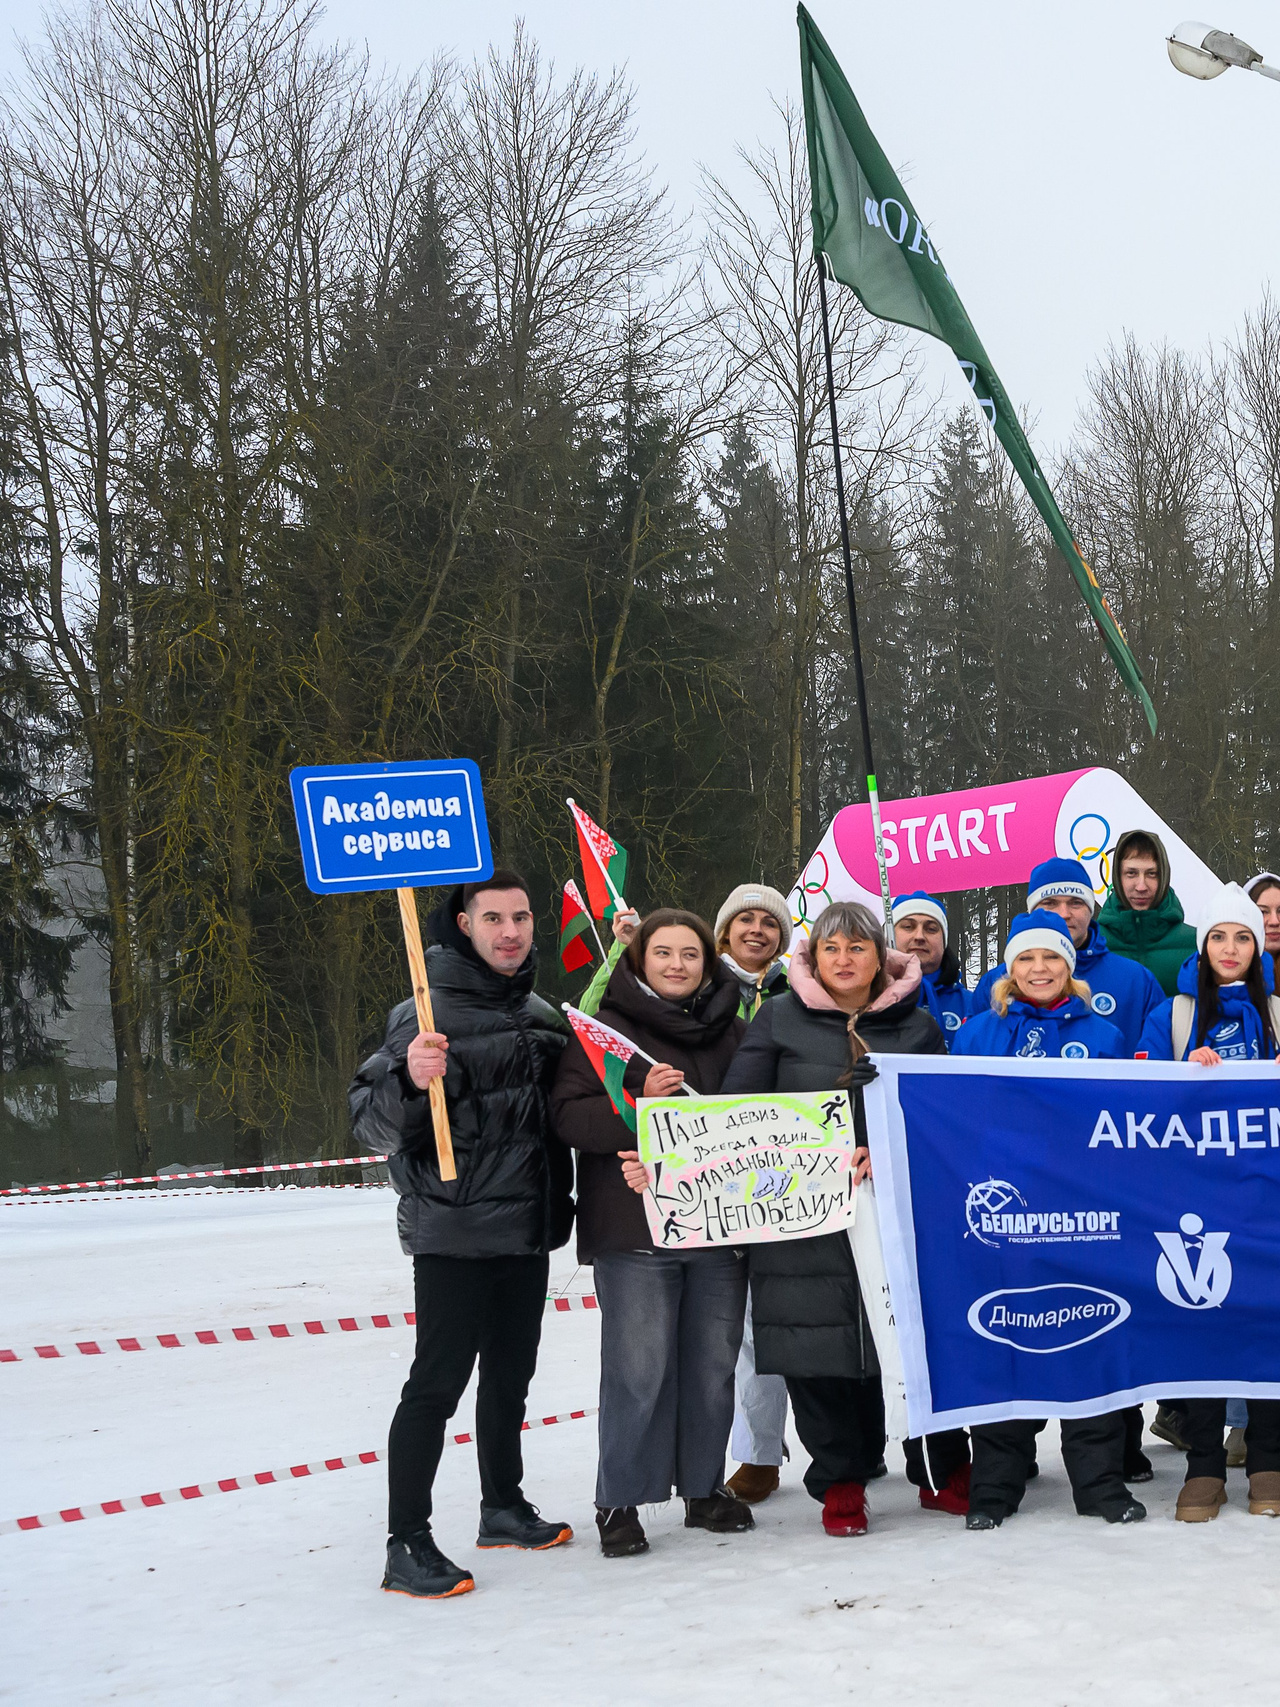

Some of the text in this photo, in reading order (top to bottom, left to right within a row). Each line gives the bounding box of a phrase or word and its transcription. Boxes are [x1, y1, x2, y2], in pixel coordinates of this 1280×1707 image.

[322, 791, 462, 826] Академия
[342, 829, 451, 861] сервиса
[874, 802, 1017, 868] START
[878, 861, 888, 887] POLE
[882, 890, 893, 925] STRIKE
[981, 1211, 1121, 1234] БЕЛАРУСЬТОРГ
[1008, 1234, 1121, 1243] ГОСУДАРСТВЕННОЕ ПРЕДПРИЯТИЕ
[988, 1302, 1115, 1328] Дипмаркет
